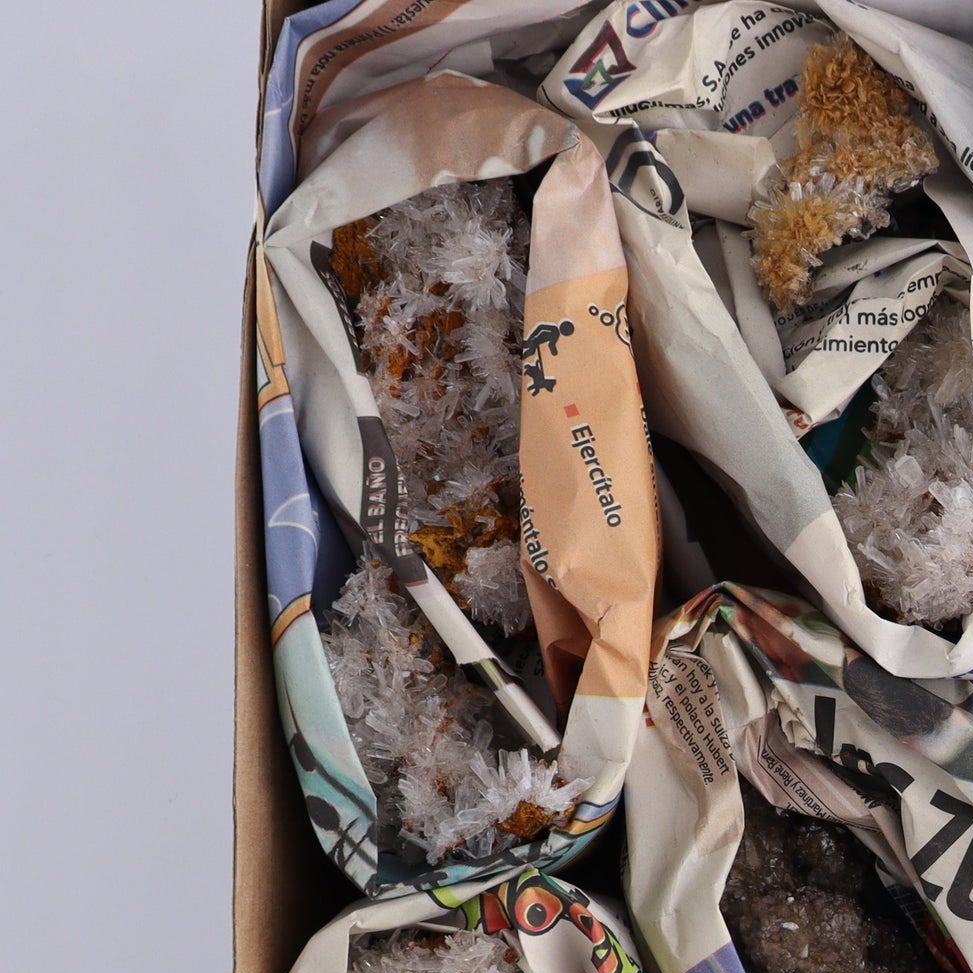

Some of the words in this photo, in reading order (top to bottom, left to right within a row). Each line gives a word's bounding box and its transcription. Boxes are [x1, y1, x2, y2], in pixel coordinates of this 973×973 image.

[310, 51, 336, 77] nota
[723, 100, 766, 133] una
[857, 307, 898, 326] más
[366, 457, 386, 514] BAÑO
[571, 423, 622, 528] Ejercítalo
[675, 684, 687, 697] el
[679, 695, 705, 734] polaco
[686, 670, 703, 695] hoy
[705, 702, 714, 717] la
[711, 717, 731, 749] suiza
[662, 695, 714, 786] respectivamente.
[703, 733, 729, 776] Hubert
[774, 766, 795, 789] René
[801, 789, 826, 818] Martínez
